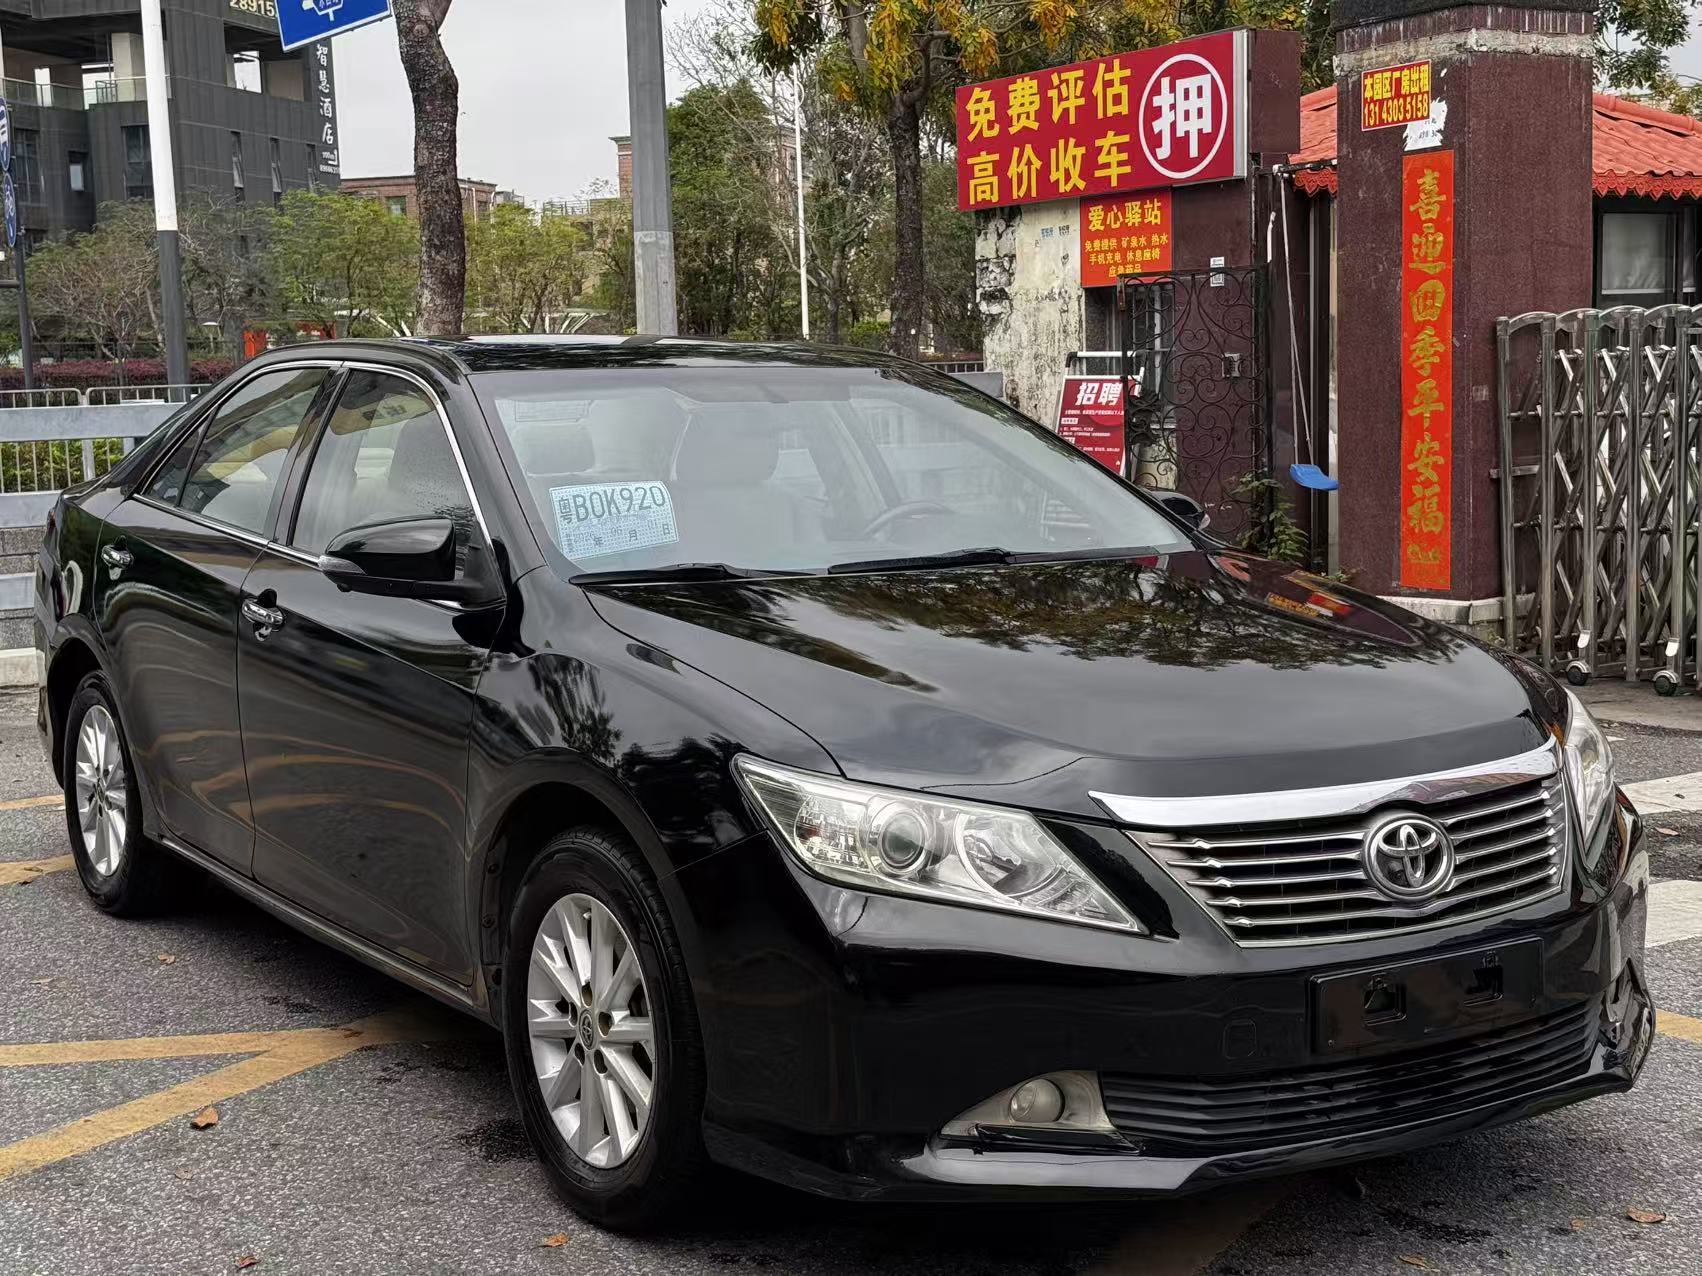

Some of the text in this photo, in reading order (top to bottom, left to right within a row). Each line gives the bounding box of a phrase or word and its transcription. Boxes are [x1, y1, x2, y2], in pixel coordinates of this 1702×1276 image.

[316, 44, 334, 144] 智慧酒店
[965, 58, 1132, 142] 免费评估
[1364, 64, 1429, 102] 本园区厂房出租
[1152, 73, 1212, 160] 押
[1364, 93, 1428, 127] 131 4303 5158
[966, 130, 1132, 205] 高价收车
[1088, 198, 1161, 231] 爱心驿站
[1085, 232, 1168, 252] 免费提供 矿泉水 热水
[1089, 247, 1160, 266] 手机充电 休息座椅
[1075, 381, 1123, 406] 招聘
